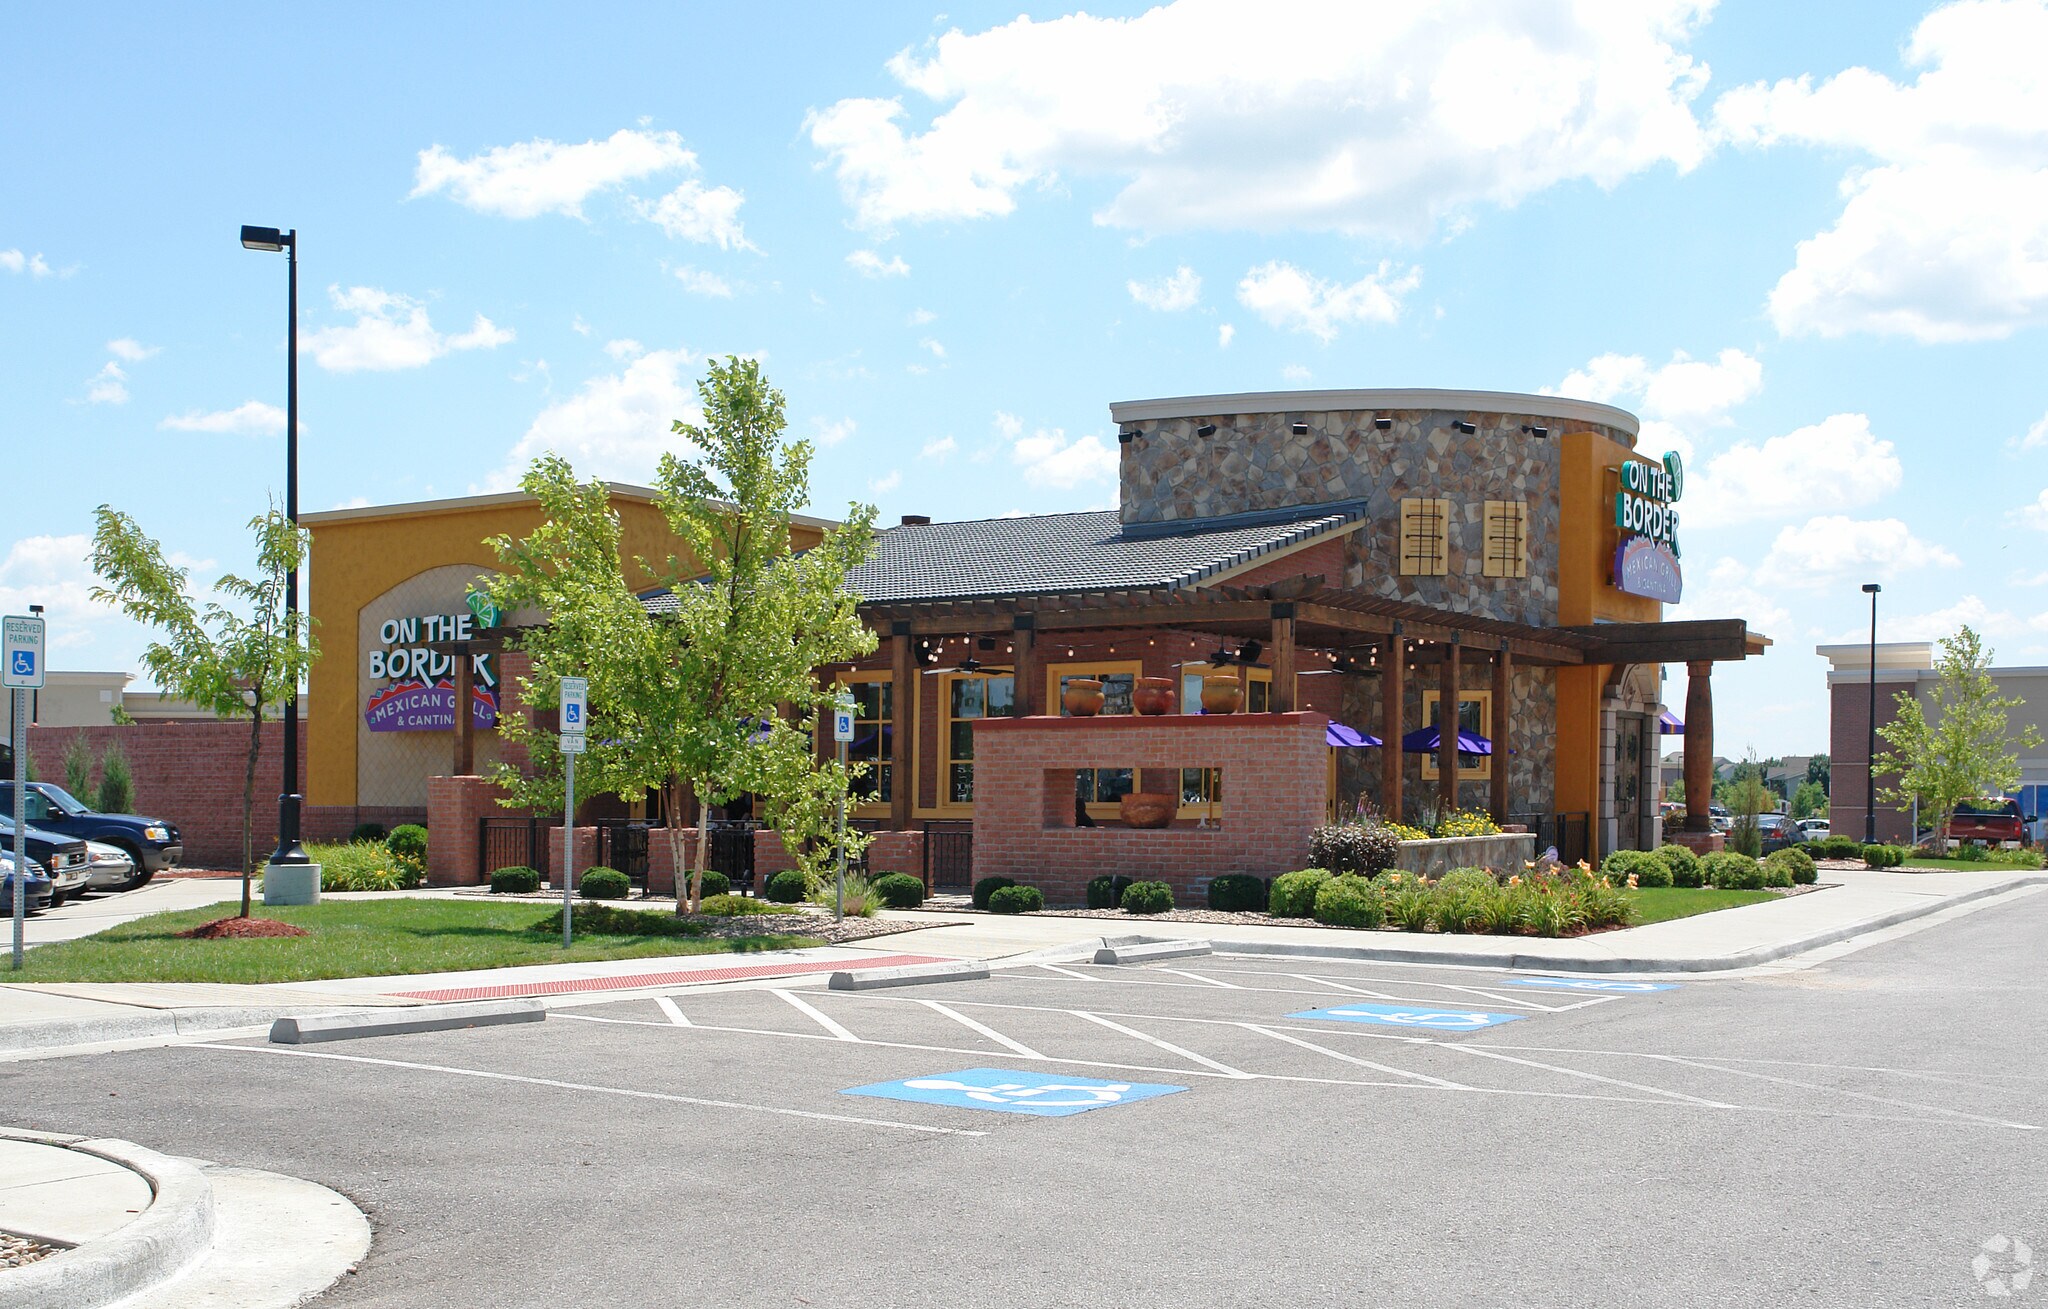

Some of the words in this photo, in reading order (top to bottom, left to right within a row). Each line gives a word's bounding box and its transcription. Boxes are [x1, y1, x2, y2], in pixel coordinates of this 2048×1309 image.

[1629, 460, 1649, 493] ON
[1650, 466, 1673, 503] THE
[1623, 492, 1682, 559] BORDER
[1626, 555, 1659, 577] MEXICAN
[1660, 562, 1678, 593] GRILL
[6, 622, 42, 633] RESERVED
[9, 634, 39, 644] PARKING
[380, 617, 418, 644] ON
[423, 614, 473, 643] THE
[369, 648, 496, 689] BORDR
[375, 694, 441, 723] MEXICAN
[446, 695, 486, 720] GLL
[397, 716, 405, 726] &
[408, 714, 456, 726] CANTIN
